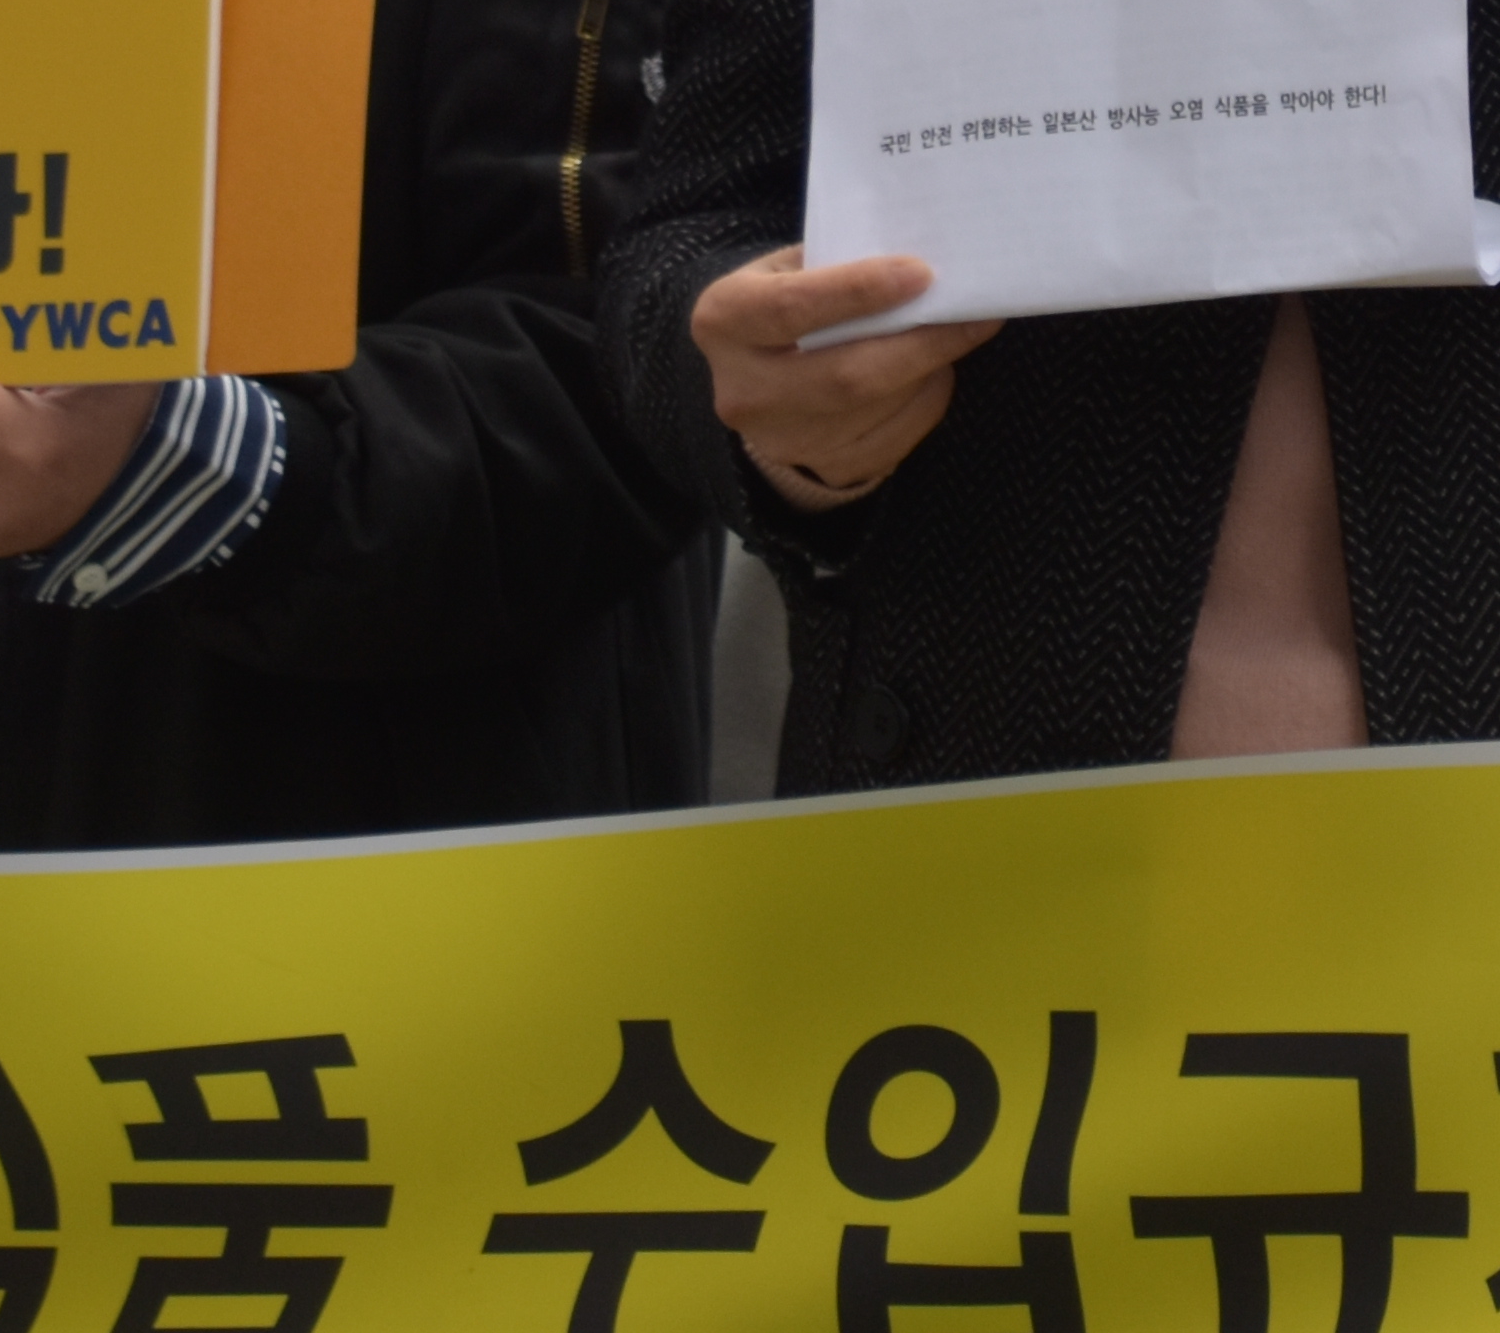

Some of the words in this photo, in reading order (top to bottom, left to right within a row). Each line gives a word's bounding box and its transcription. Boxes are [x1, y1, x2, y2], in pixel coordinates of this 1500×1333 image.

[880, 132, 912, 156] 국민
[961, 115, 1033, 142] 위협하는
[1042, 109, 1097, 135] 일본산
[1107, 104, 1160, 130] 방사능
[1169, 98, 1204, 121] 오염
[1214, 92, 1270, 118] 식품을
[1280, 88, 1335, 114] 막아야
[1344, 84, 1388, 109] 한다!
